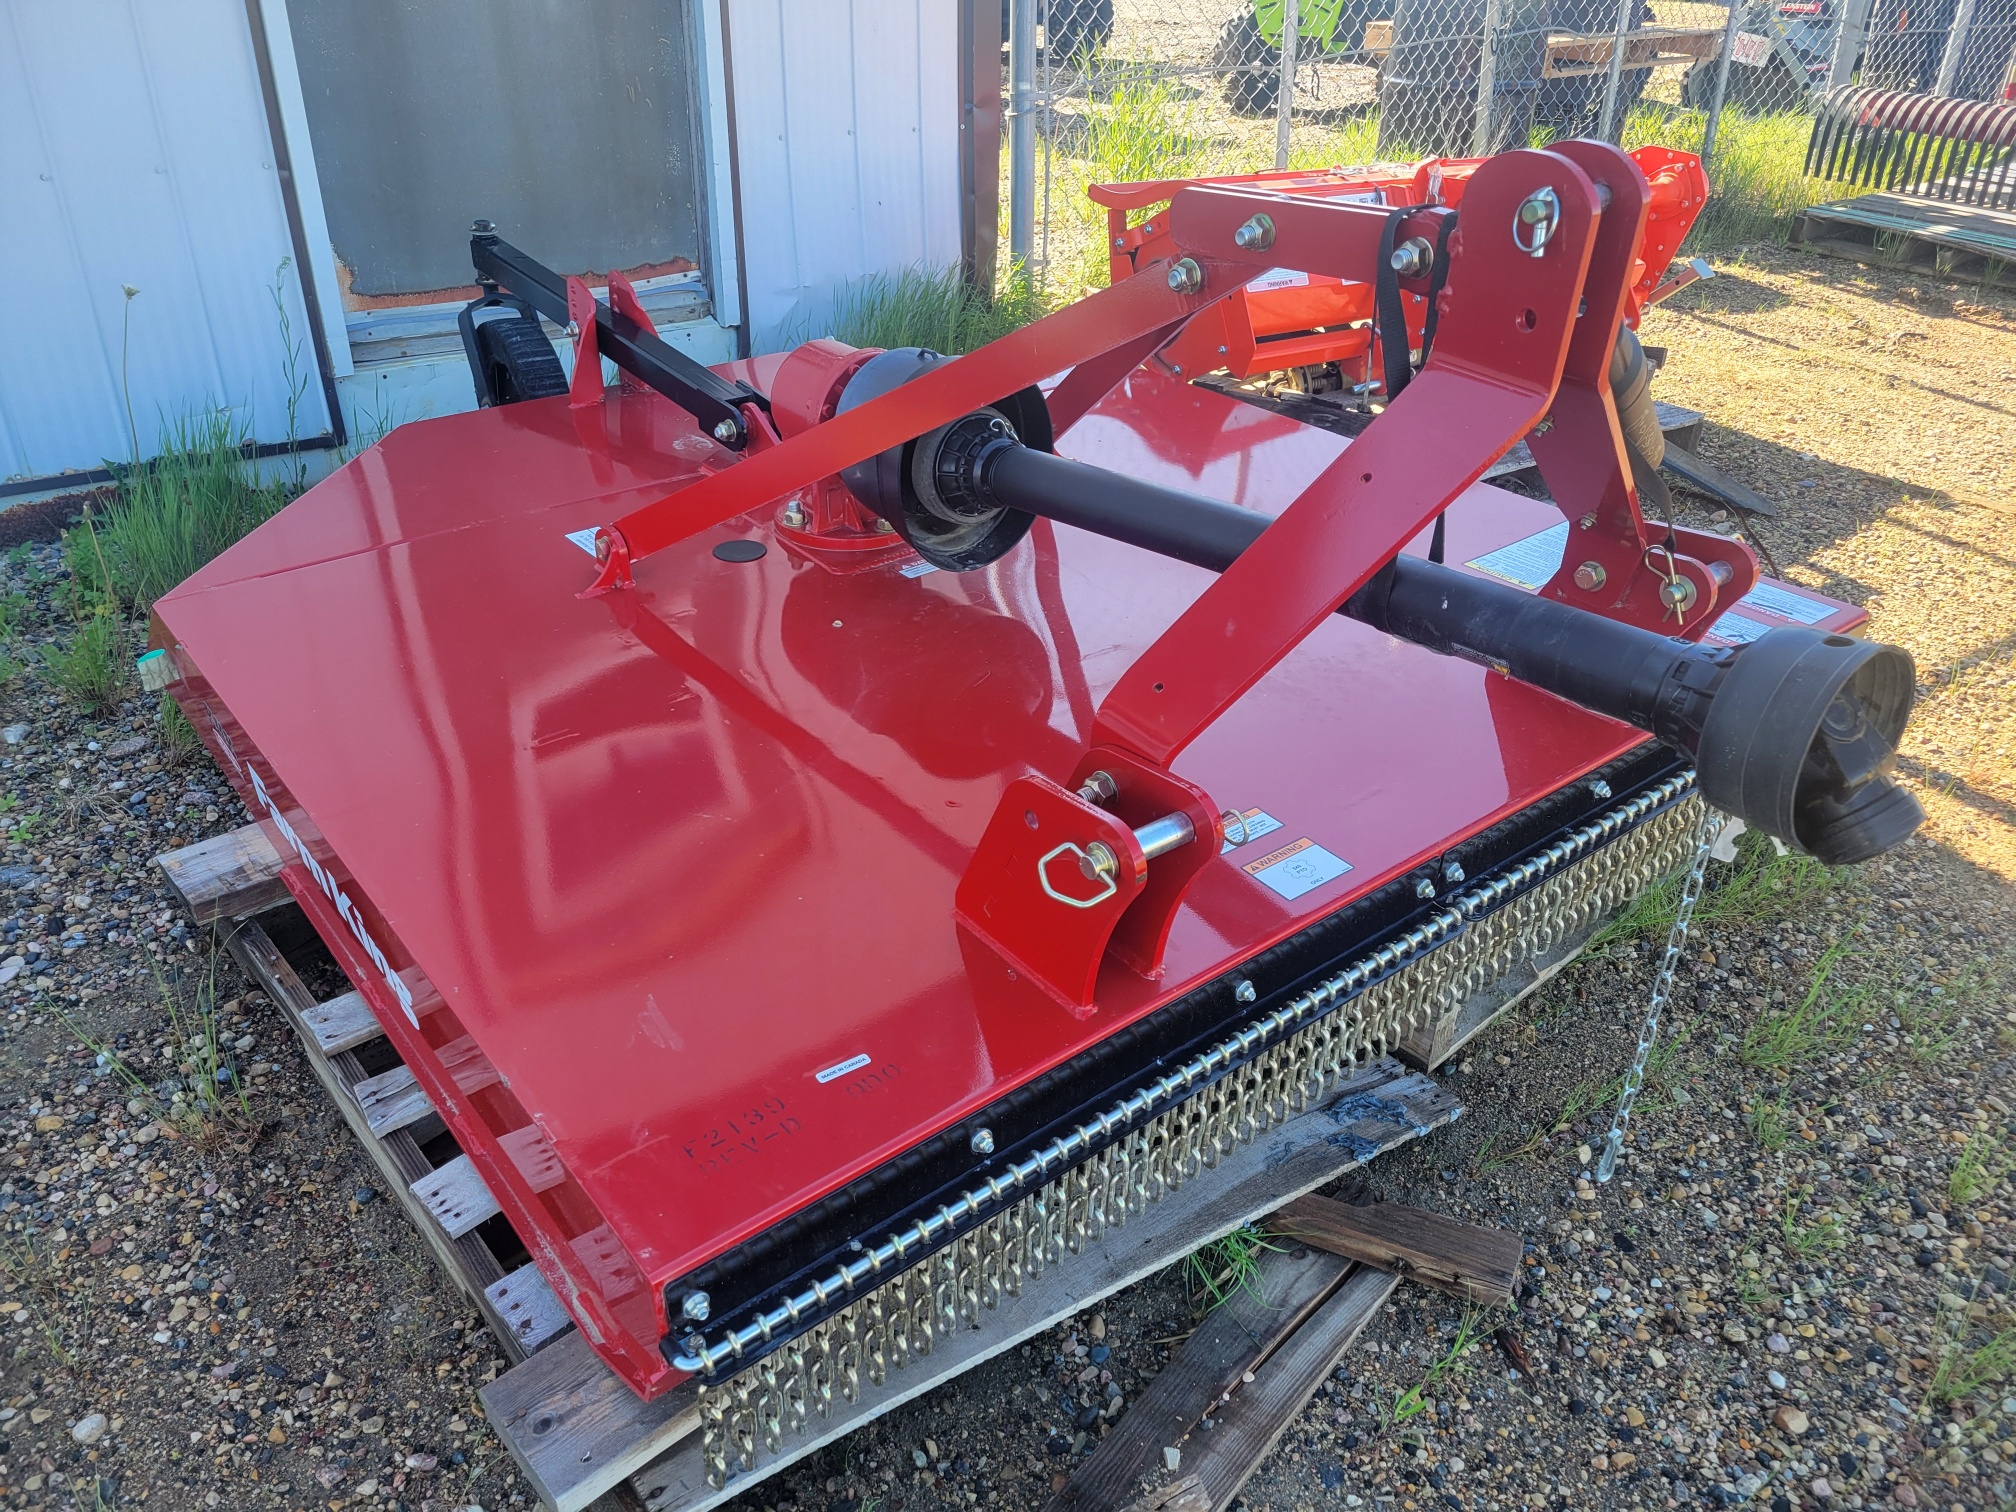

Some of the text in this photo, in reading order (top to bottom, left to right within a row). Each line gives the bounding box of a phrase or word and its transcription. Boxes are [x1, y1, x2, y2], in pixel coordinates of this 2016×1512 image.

[1257, 843, 1303, 866] WARNING
[1310, 876, 1324, 885] ONLY
[821, 1069, 838, 1079] MADE
[844, 1057, 867, 1070] CANADA
